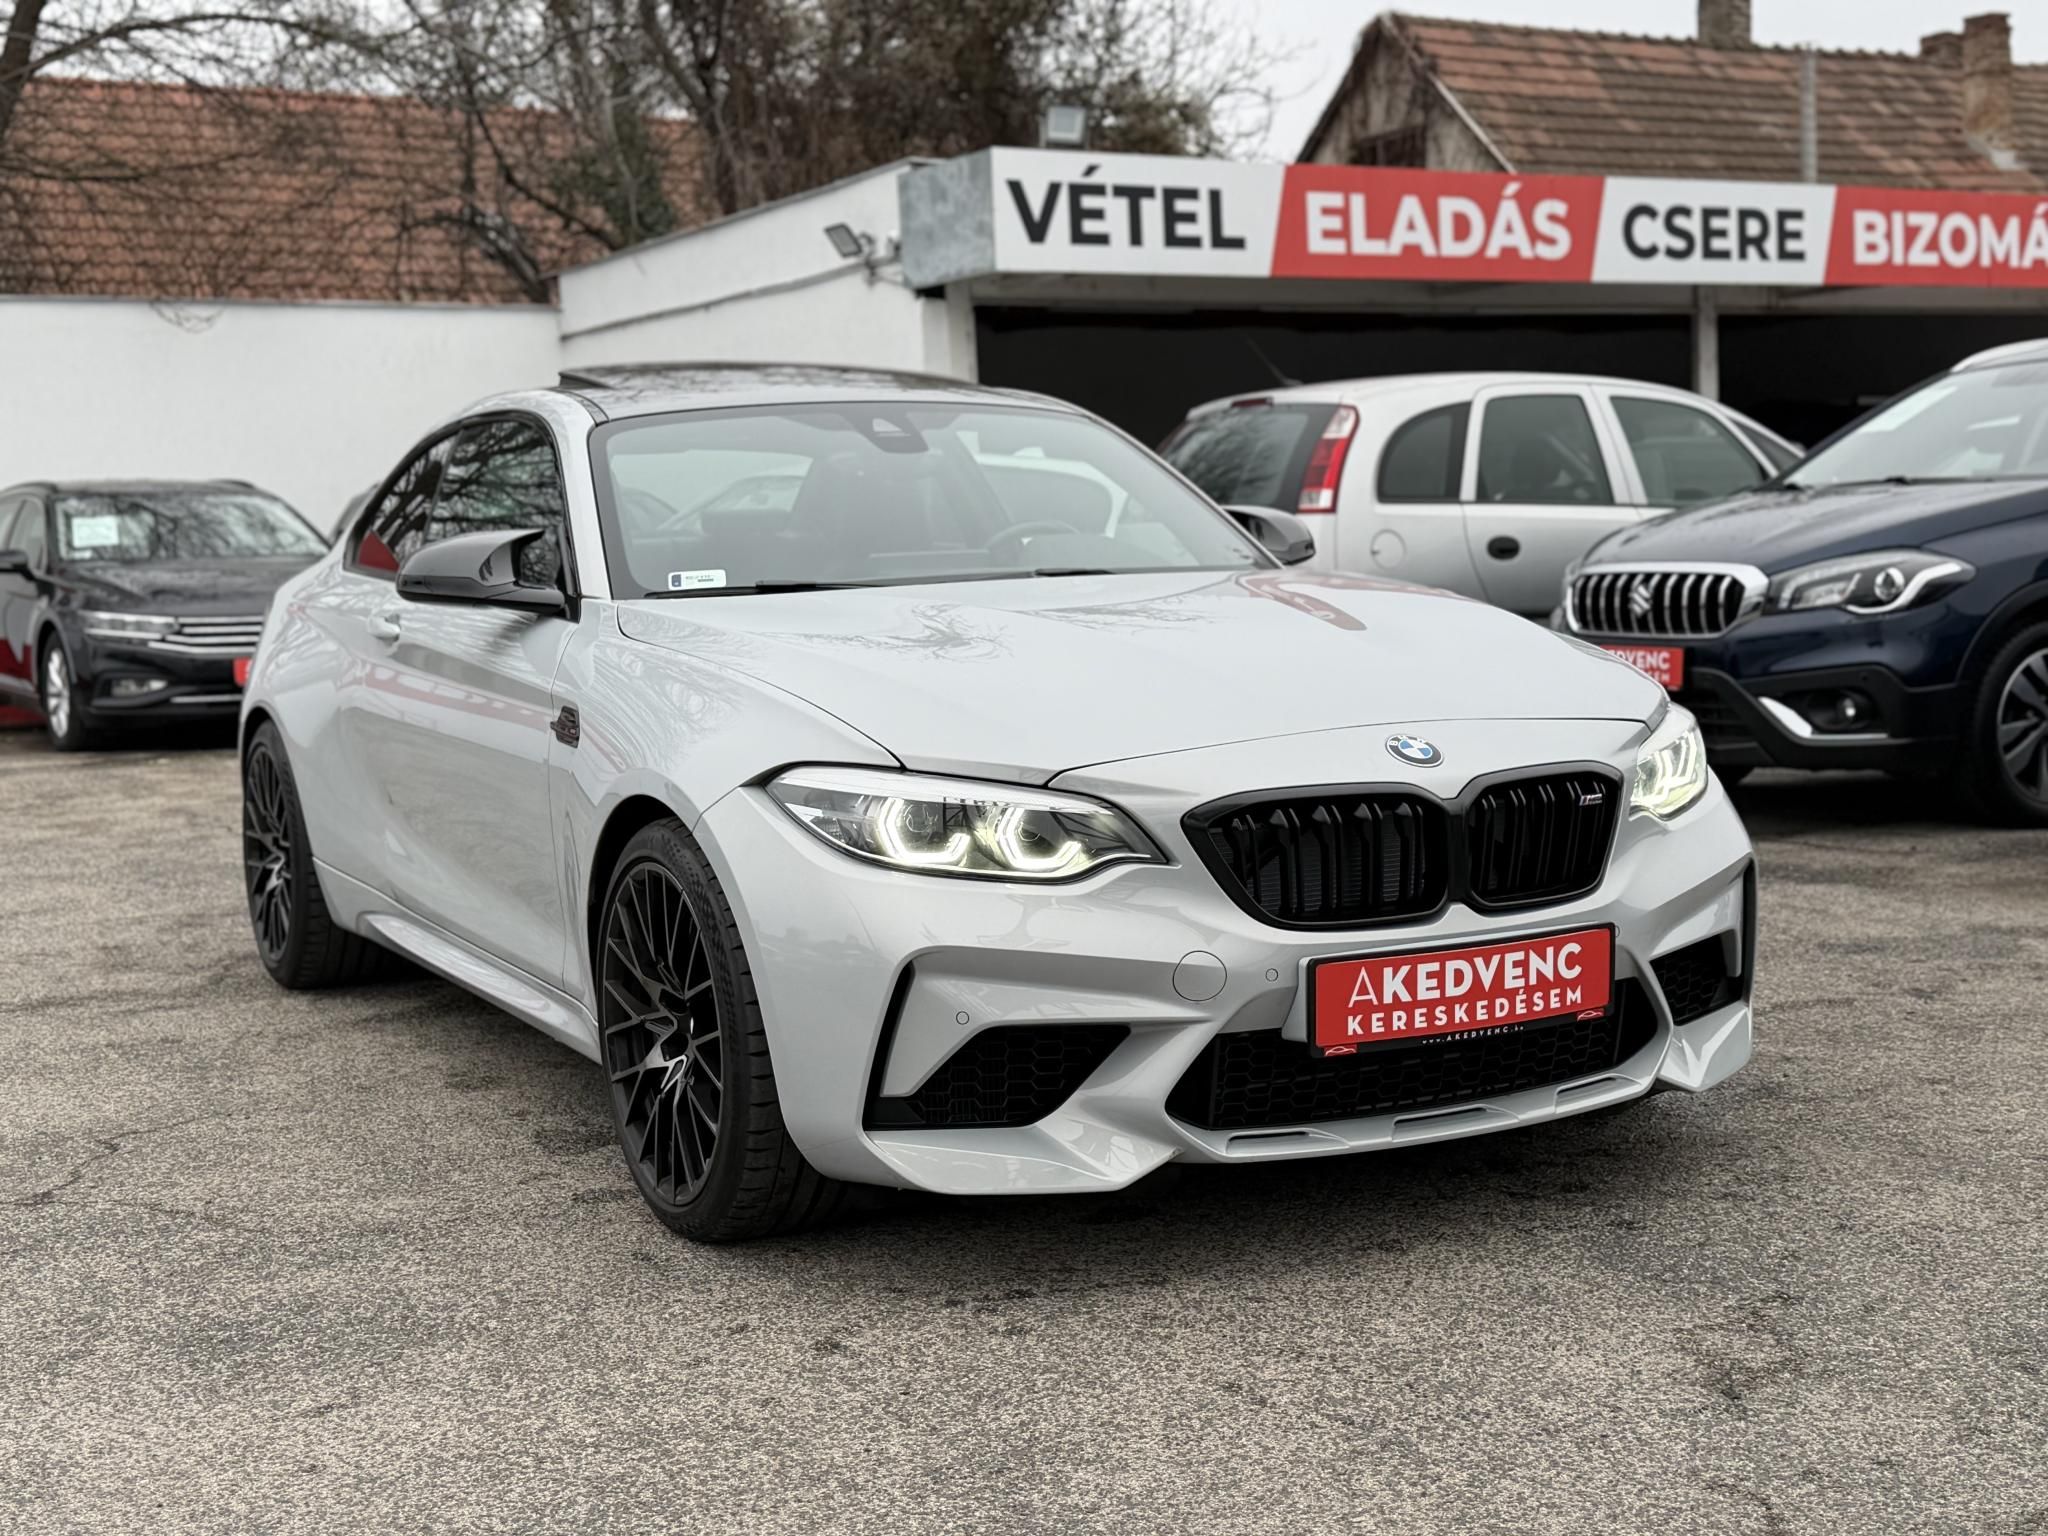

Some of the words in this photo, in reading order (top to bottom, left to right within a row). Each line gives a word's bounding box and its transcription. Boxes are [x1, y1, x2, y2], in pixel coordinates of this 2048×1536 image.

[1006, 164, 1246, 251] VÉTEL
[1305, 182, 1572, 261] ELADÁS
[1623, 204, 1807, 262] CSERE
[1346, 985, 1583, 1037] KERESKEDÉSEM
